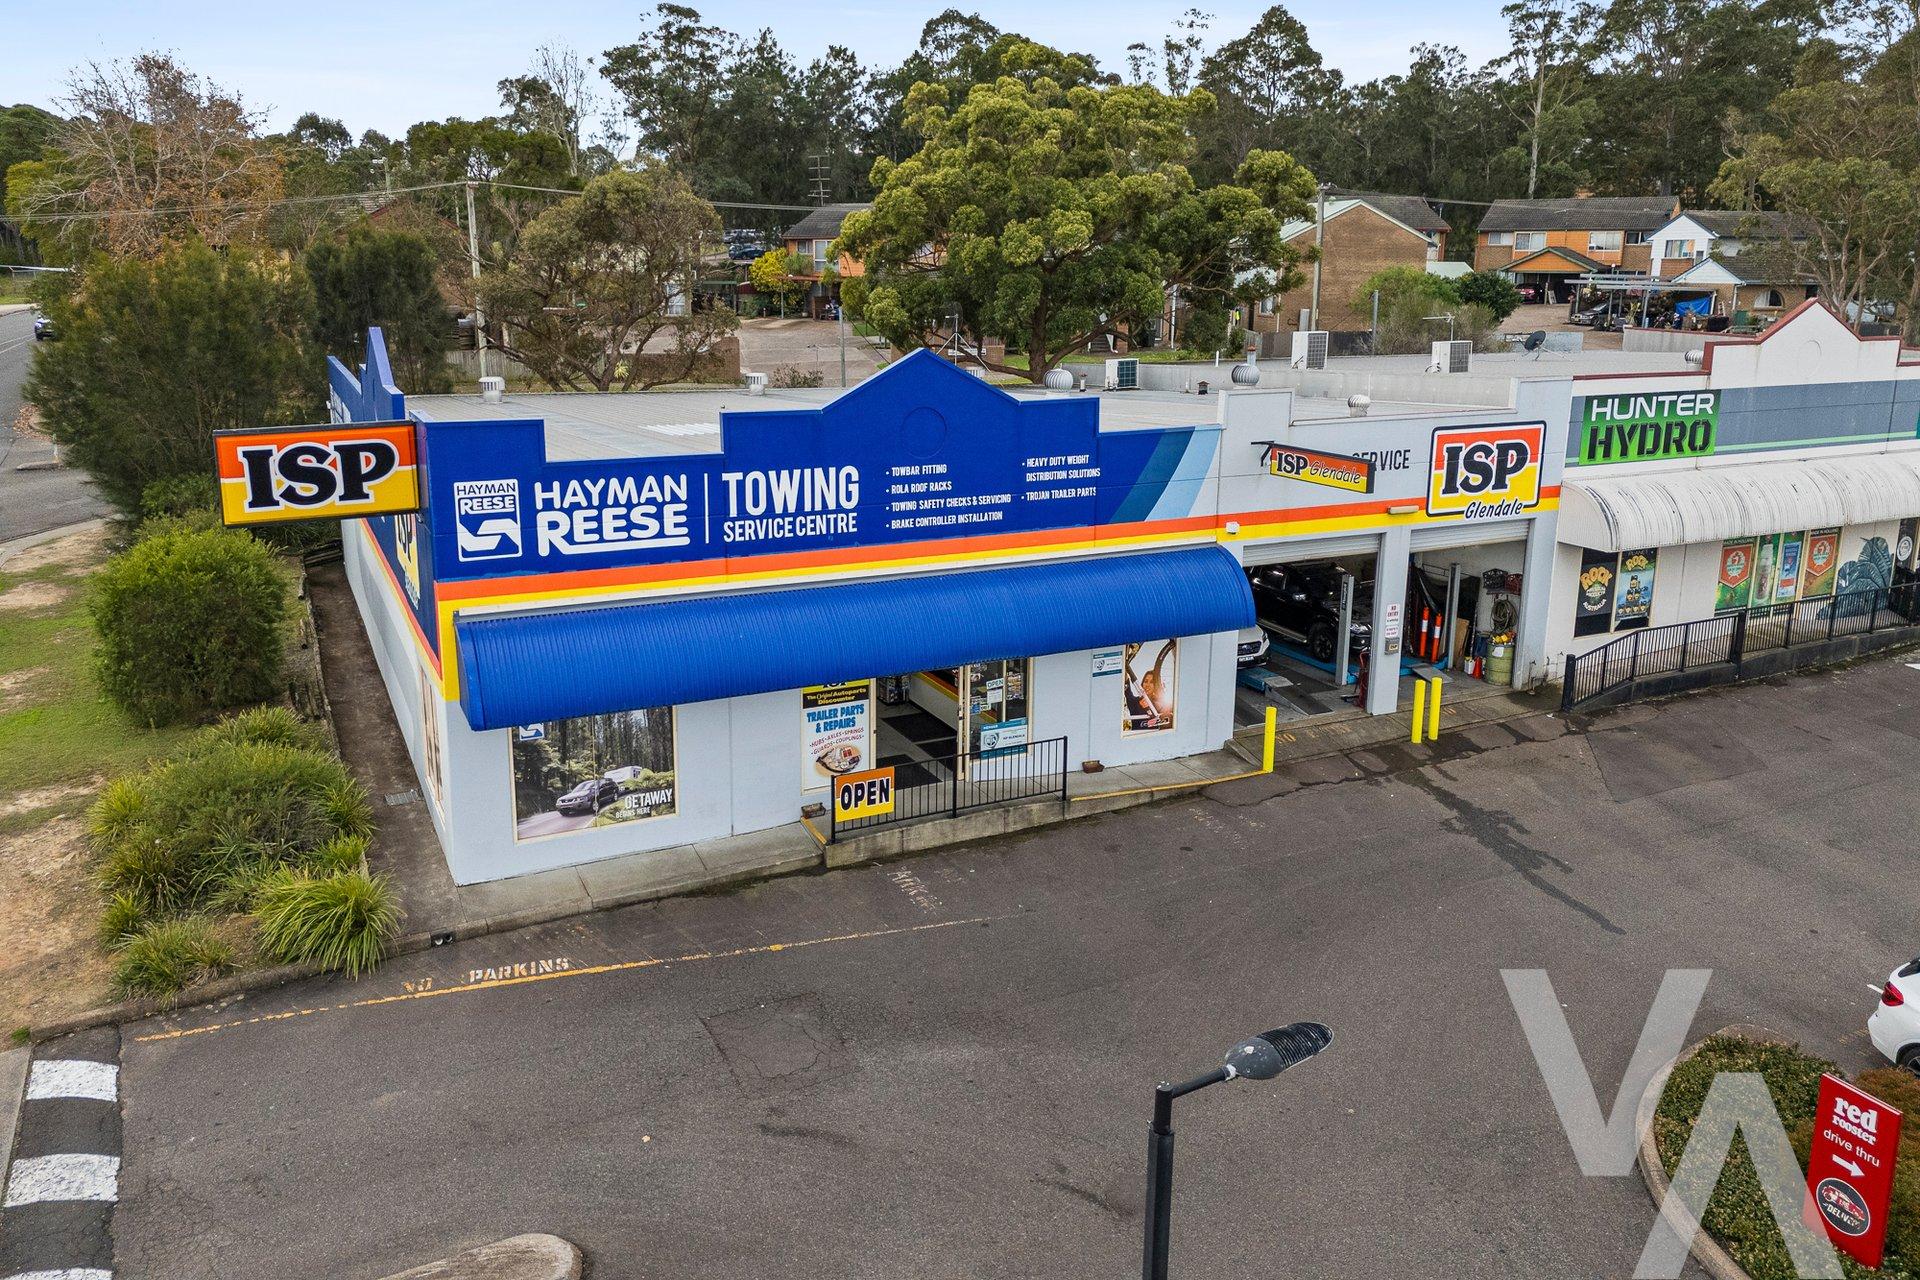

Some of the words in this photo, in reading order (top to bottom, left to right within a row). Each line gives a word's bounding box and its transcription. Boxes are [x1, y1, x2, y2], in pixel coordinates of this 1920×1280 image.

[1591, 392, 1715, 421] HUNTER
[1587, 419, 1712, 460] HYDRO
[891, 466, 920, 477] TOWBAR
[922, 464, 947, 475] FITTING
[1026, 457, 1048, 468] HEAVY
[1049, 456, 1066, 466] DUTY
[1067, 454, 1090, 465] WEIGHT
[1276, 451, 1309, 476] ISP
[1309, 457, 1362, 485] Glendale
[1352, 449, 1411, 471] RVICE
[1441, 438, 1531, 496] ISP
[239, 439, 398, 512] ISP
[1026, 470, 1067, 482] DISTRIBUTION
[1068, 468, 1101, 479] SOLUTIONS
[457, 483, 516, 496] HAYMAN
[534, 474, 687, 510] HAYMAN
[722, 466, 860, 518] TOWING
[891, 484, 909, 494] ROLA
[911, 482, 928, 493] ROOF
[929, 481, 952, 491] RACKS
[1026, 490, 1050, 501] TROJAN
[1050, 488, 1076, 499] TRAILER
[1076, 486, 1097, 497] PARTS
[460, 496, 515, 516] REESE
[891, 501, 917, 512] TOWING
[919, 499, 945, 510] SAFETY
[946, 496, 971, 507] CHECKS
[972, 496, 978, 506] &
[978, 494, 1011, 504] SERVICING
[1464, 498, 1524, 520] Glendale
[537, 503, 690, 557] REESE
[723, 516, 798, 543] SERVICE
[799, 512, 858, 540] CENTRE
[891, 518, 914, 529] BRAKE
[915, 515, 957, 527] CONTROLLER
[957, 511, 1003, 524] INSTALLATION
[832, 687, 866, 697] Autoparts
[987, 678, 1004, 688] OPEN
[818, 695, 856, 705] Discounter
[807, 708, 838, 723] TRAILER
[840, 704, 865, 717] PARTS
[815, 722, 822, 733] &
[823, 717, 856, 732] REPAIRS
[624, 788, 673, 809] GETAWAY
[840, 777, 890, 811] OPEN
[615, 809, 636, 819] BEGINS
[636, 806, 651, 815] HERE
[1834, 1097, 1878, 1133] red
[1832, 1114, 1877, 1146] rooster
[1823, 1128, 1853, 1152] drive
[1855, 1145, 1881, 1168] thru
